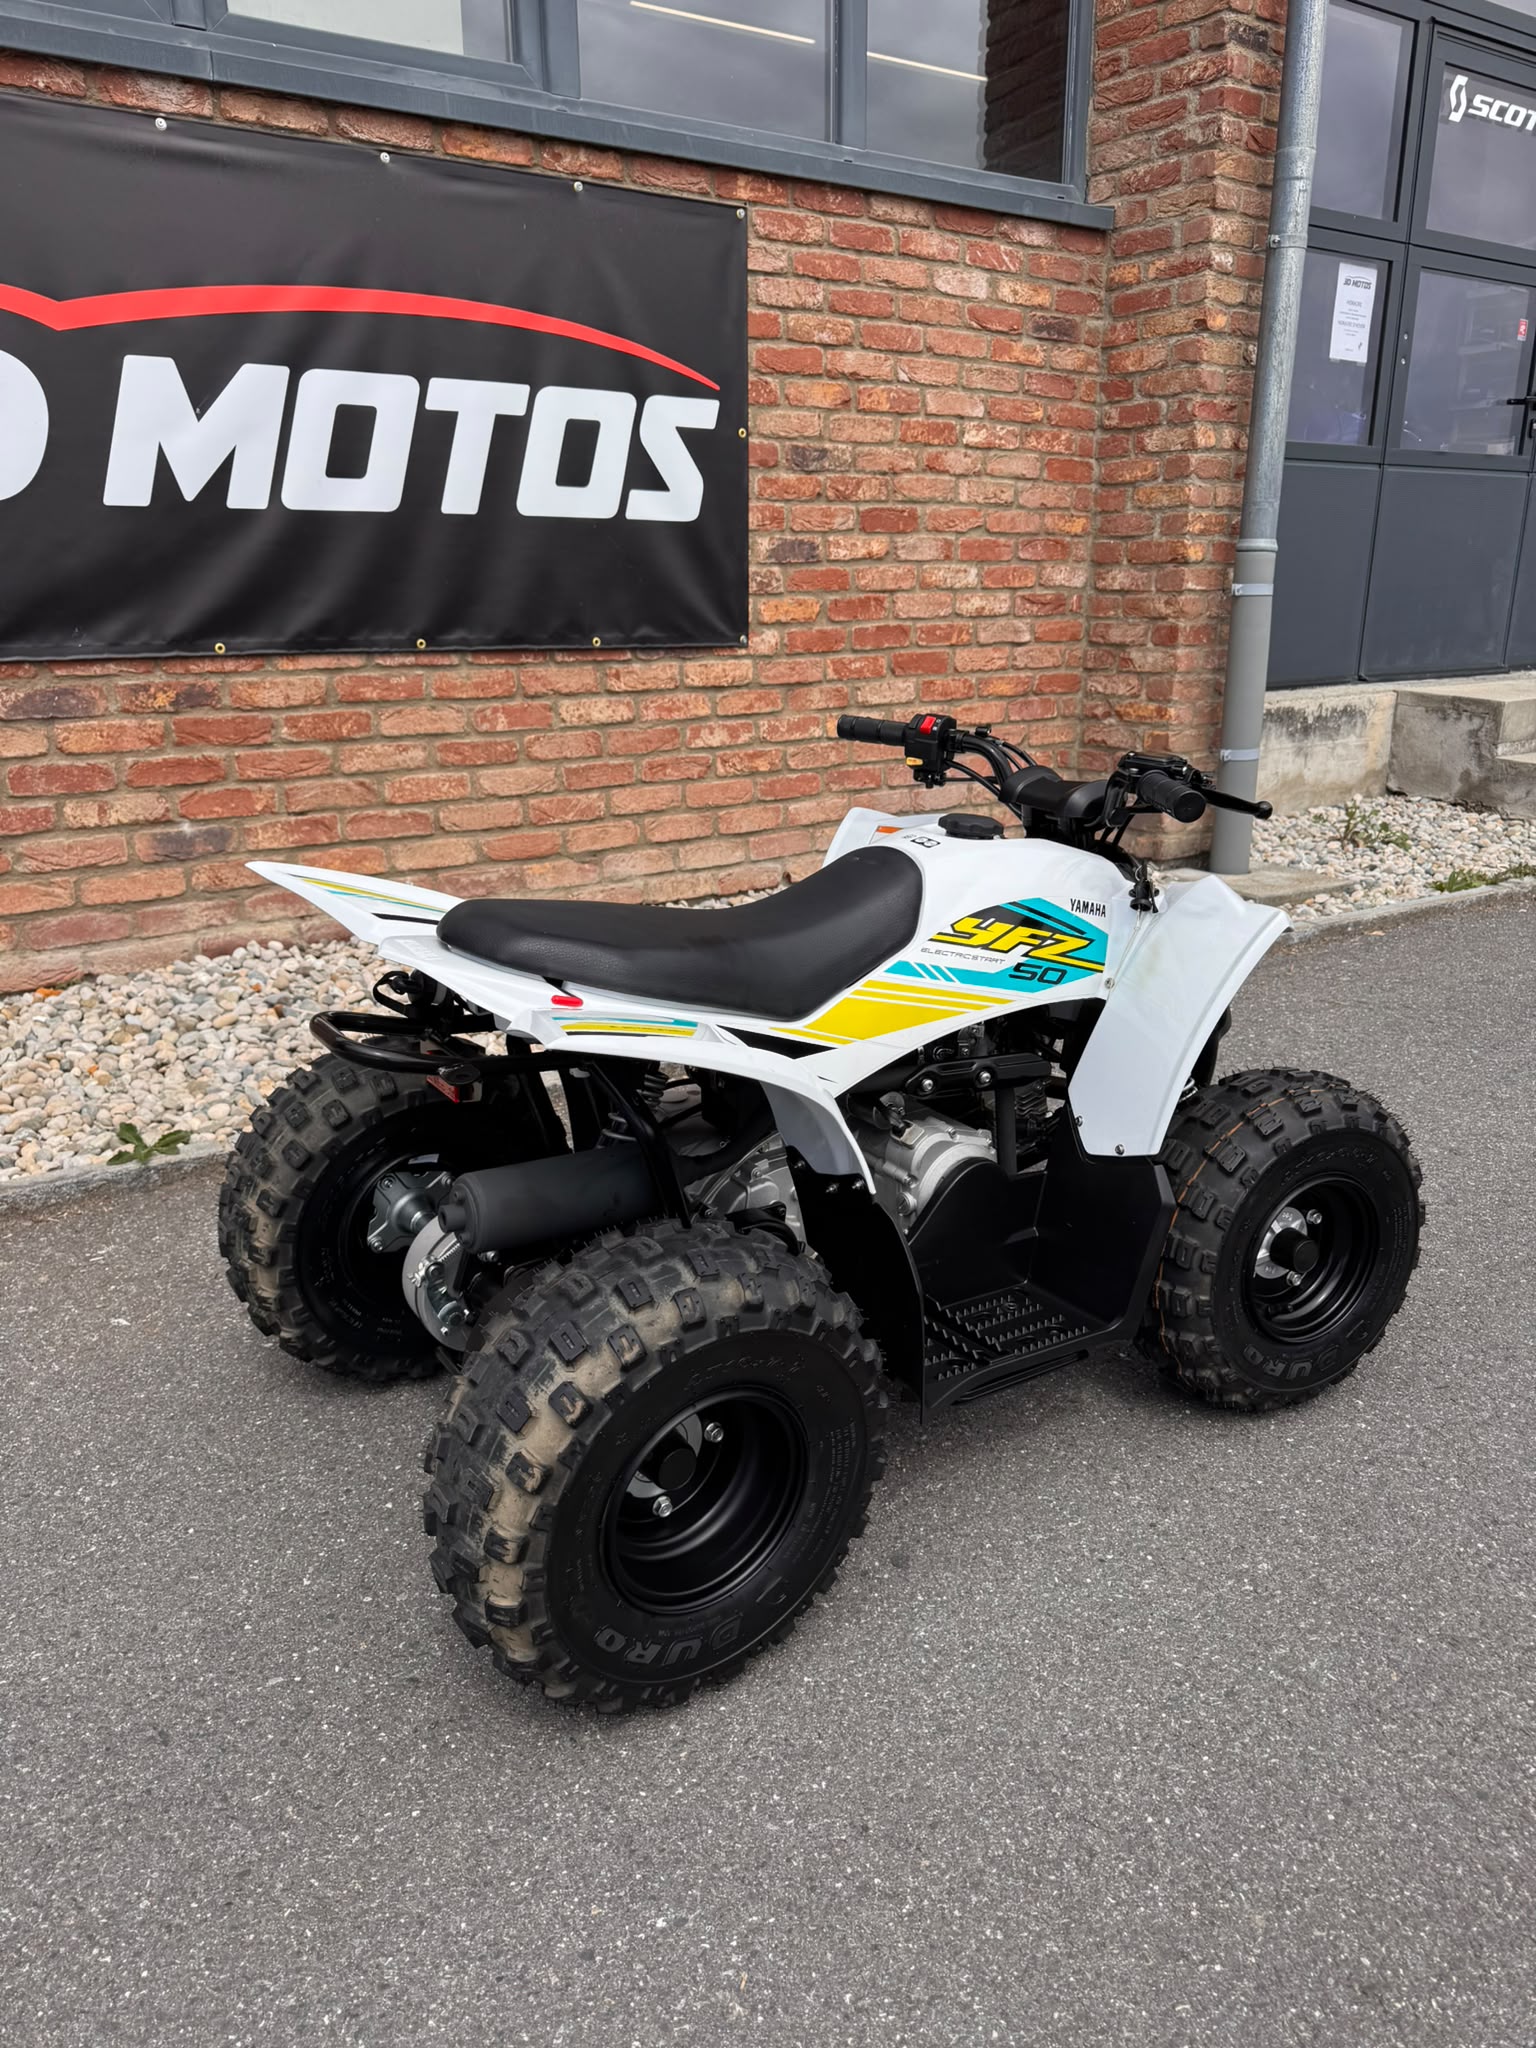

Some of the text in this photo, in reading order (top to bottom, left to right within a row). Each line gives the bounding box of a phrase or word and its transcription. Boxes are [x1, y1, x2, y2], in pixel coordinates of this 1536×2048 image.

[103, 354, 721, 523] MOTOS
[1070, 898, 1106, 918] YAMAHA
[928, 917, 1107, 974] YFZ
[1008, 962, 1068, 985] 50
[594, 1612, 743, 1665] DURO
